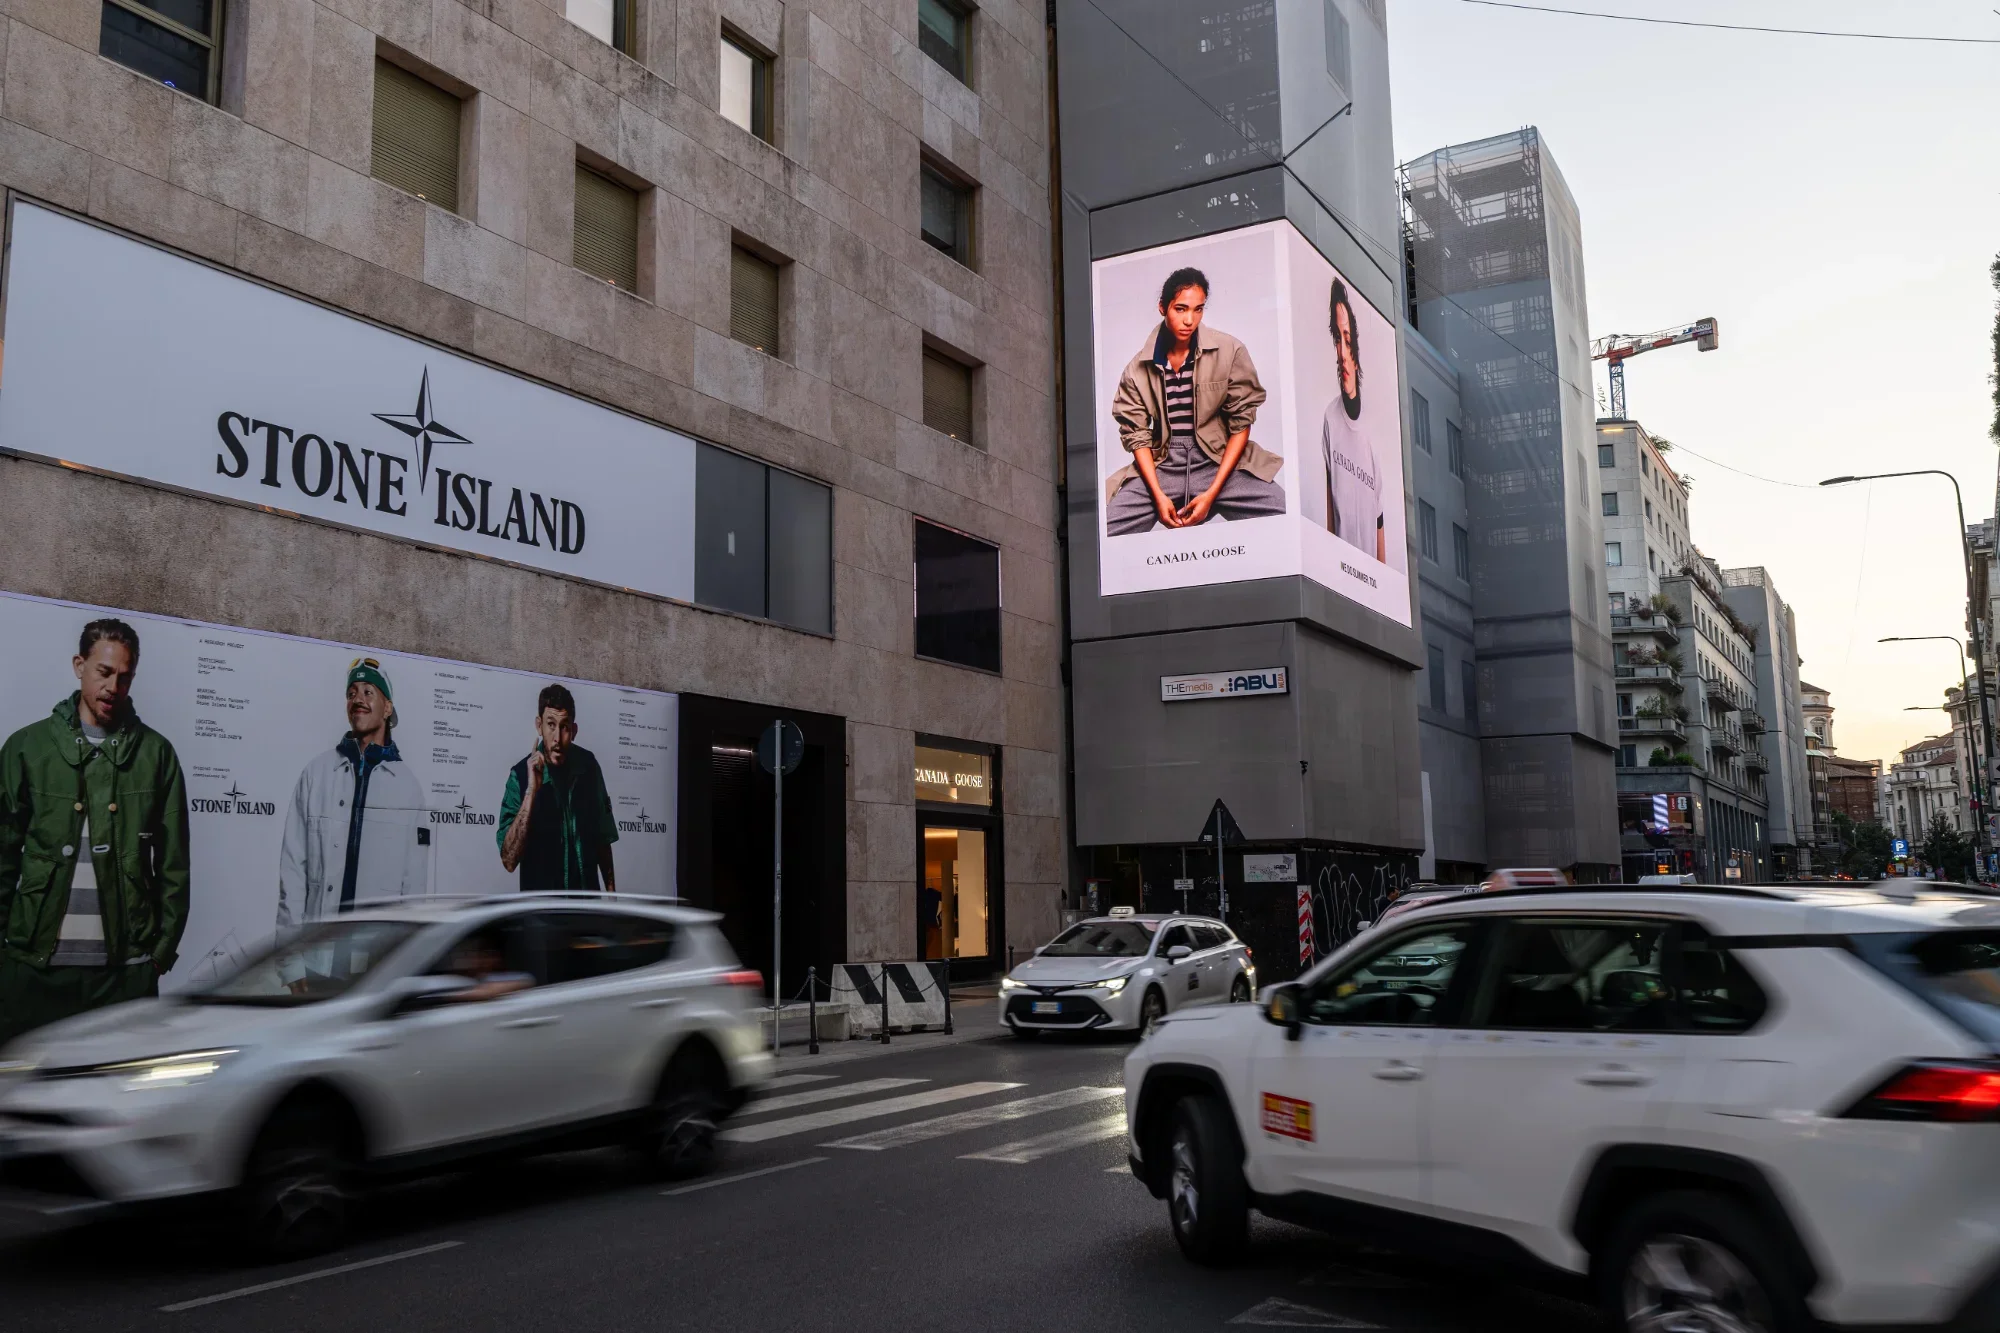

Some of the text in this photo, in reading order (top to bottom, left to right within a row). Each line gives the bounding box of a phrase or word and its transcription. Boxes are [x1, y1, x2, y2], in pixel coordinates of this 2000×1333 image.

[1333, 450, 1376, 490] CANADA GOOSE
[216, 410, 585, 555] STONE ISLAND
[1146, 545, 1246, 565] CANADA GOOSE
[1165, 682, 1214, 693] THEmedia
[954, 773, 983, 788] GOOSE
[191, 799, 275, 816] STONE ISLAND
[430, 812, 495, 825] STONE ISLAND
[618, 820, 667, 833] STONE ISLAND
